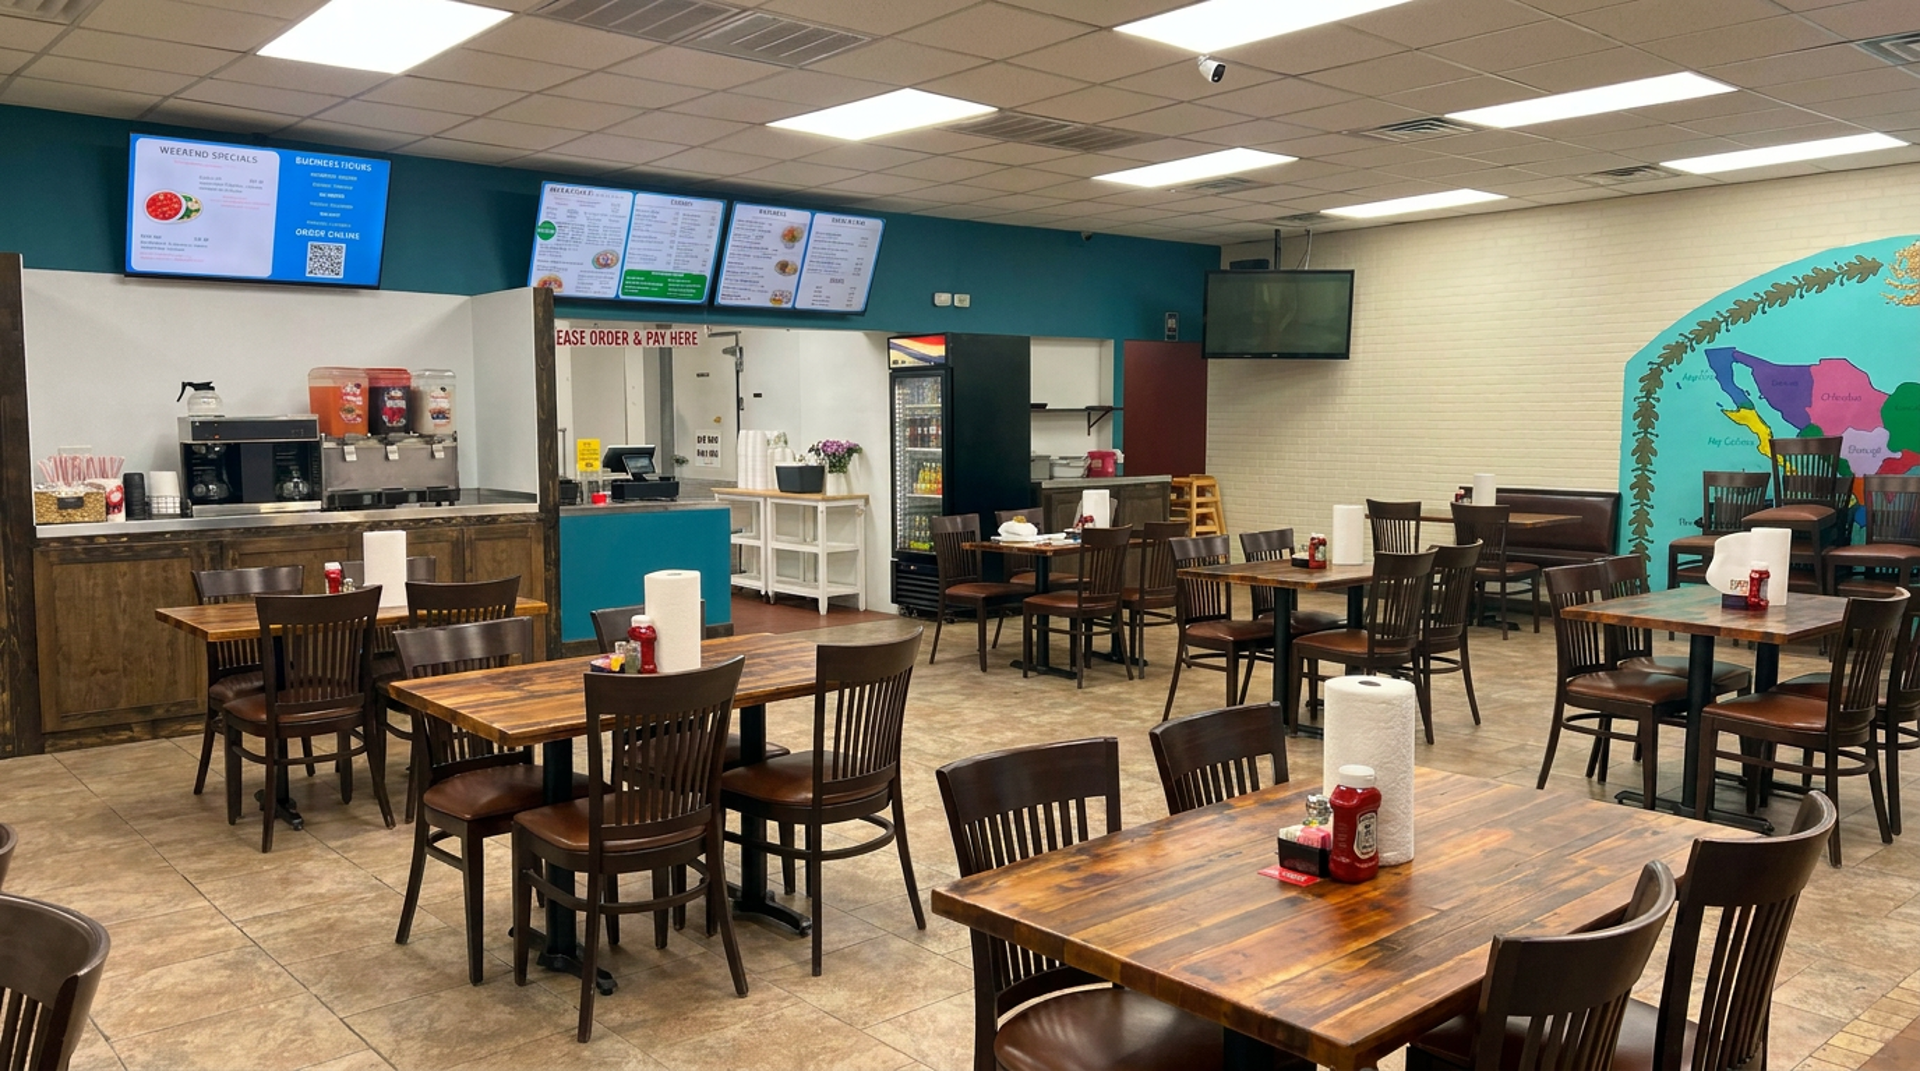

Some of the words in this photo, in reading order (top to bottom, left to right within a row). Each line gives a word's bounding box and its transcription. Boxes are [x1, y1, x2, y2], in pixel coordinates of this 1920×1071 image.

[212, 151, 258, 164] SPECIALS
[556, 330, 586, 346] EASE
[590, 330, 629, 346] ORDER
[633, 331, 642, 346] &
[646, 331, 667, 346] PAY
[670, 331, 698, 346] HERE
